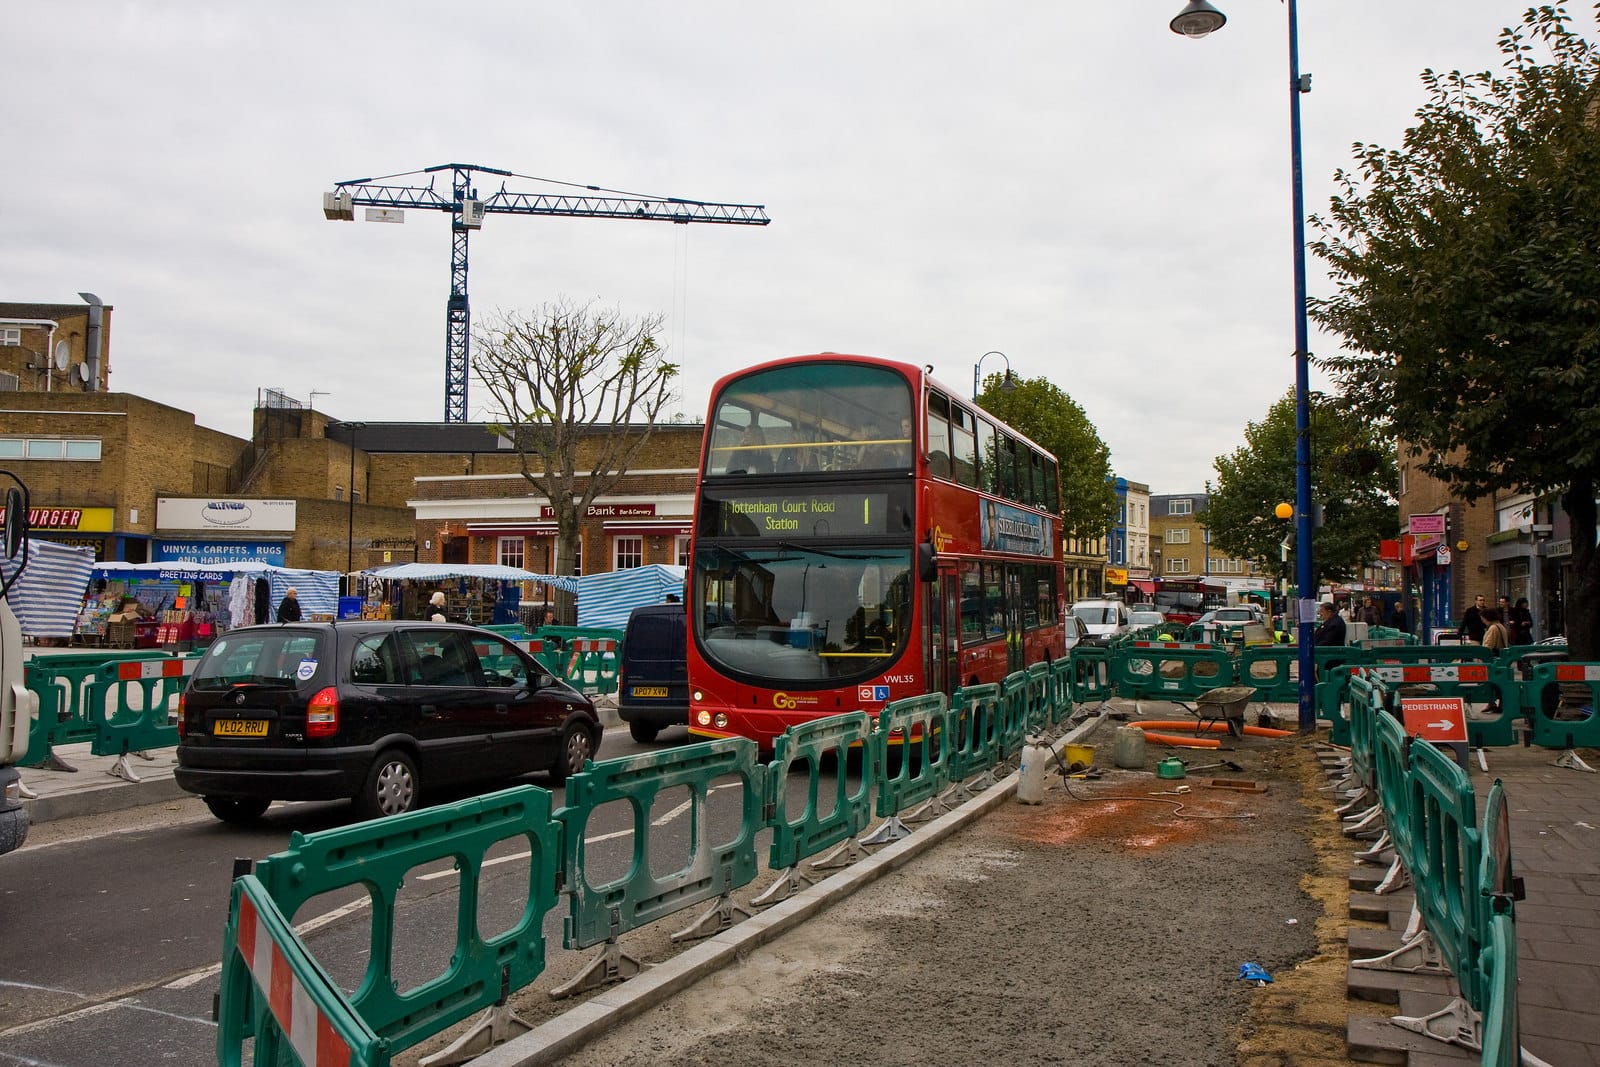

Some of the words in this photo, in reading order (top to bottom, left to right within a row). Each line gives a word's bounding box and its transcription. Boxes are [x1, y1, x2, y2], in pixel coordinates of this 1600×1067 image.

[545, 506, 554, 515] Th
[588, 506, 615, 515] Bank
[732, 499, 777, 513] Tottenham
[782, 499, 807, 513] Court
[811, 499, 834, 513] Road
[864, 497, 869, 525] 1
[766, 517, 798, 530] Station
[256, 546, 282, 555] RUGS
[159, 571, 198, 580] GREETING
[199, 572, 223, 580] CARDS
[884, 675, 913, 683] VWL35
[1402, 703, 1458, 711] PEDESTRIANS
[219, 721, 242, 733] YL02
[244, 721, 264, 733] RRU
